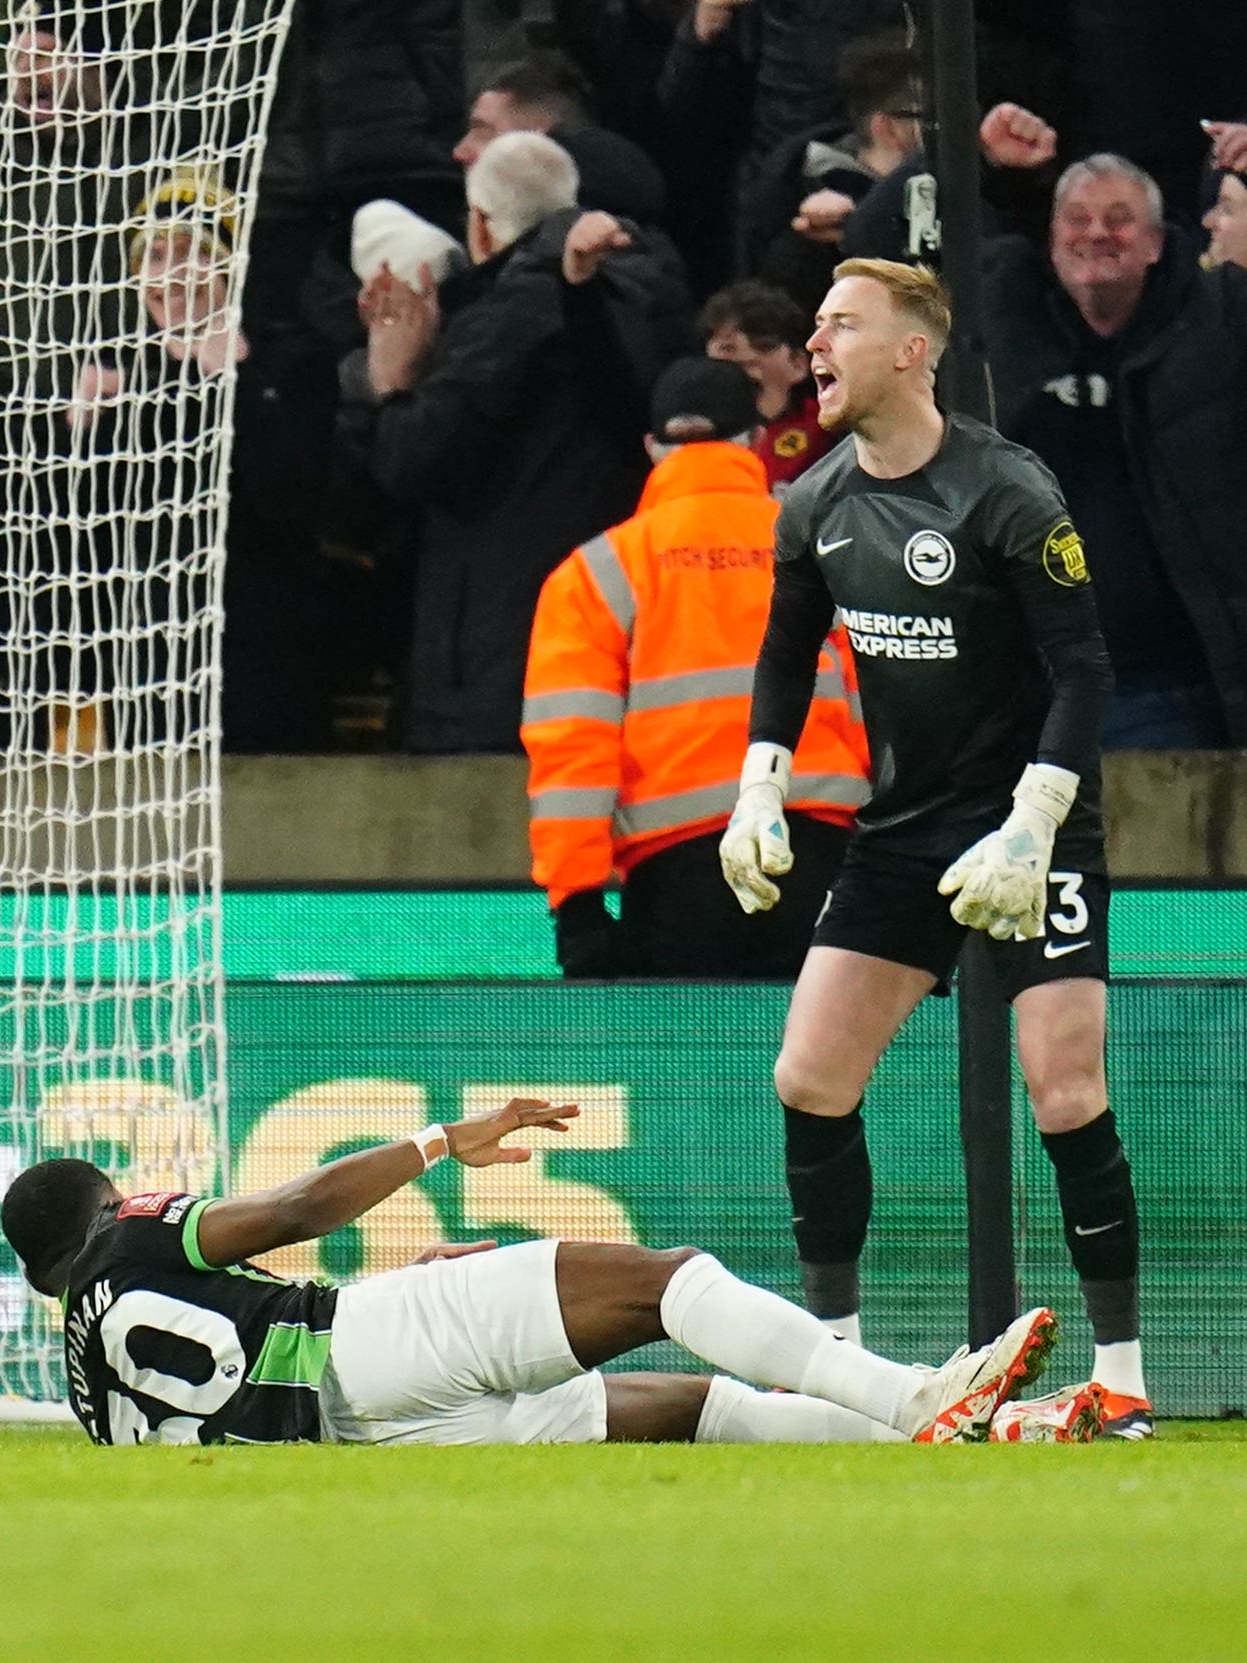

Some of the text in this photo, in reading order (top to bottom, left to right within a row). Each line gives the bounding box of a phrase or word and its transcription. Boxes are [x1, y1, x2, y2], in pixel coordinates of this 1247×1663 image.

[707, 546, 774, 571] SECURIT
[840, 607, 954, 637] MERICAN
[1014, 871, 1090, 942] 3
[67, 1278, 114, 1444] TUPINAN
